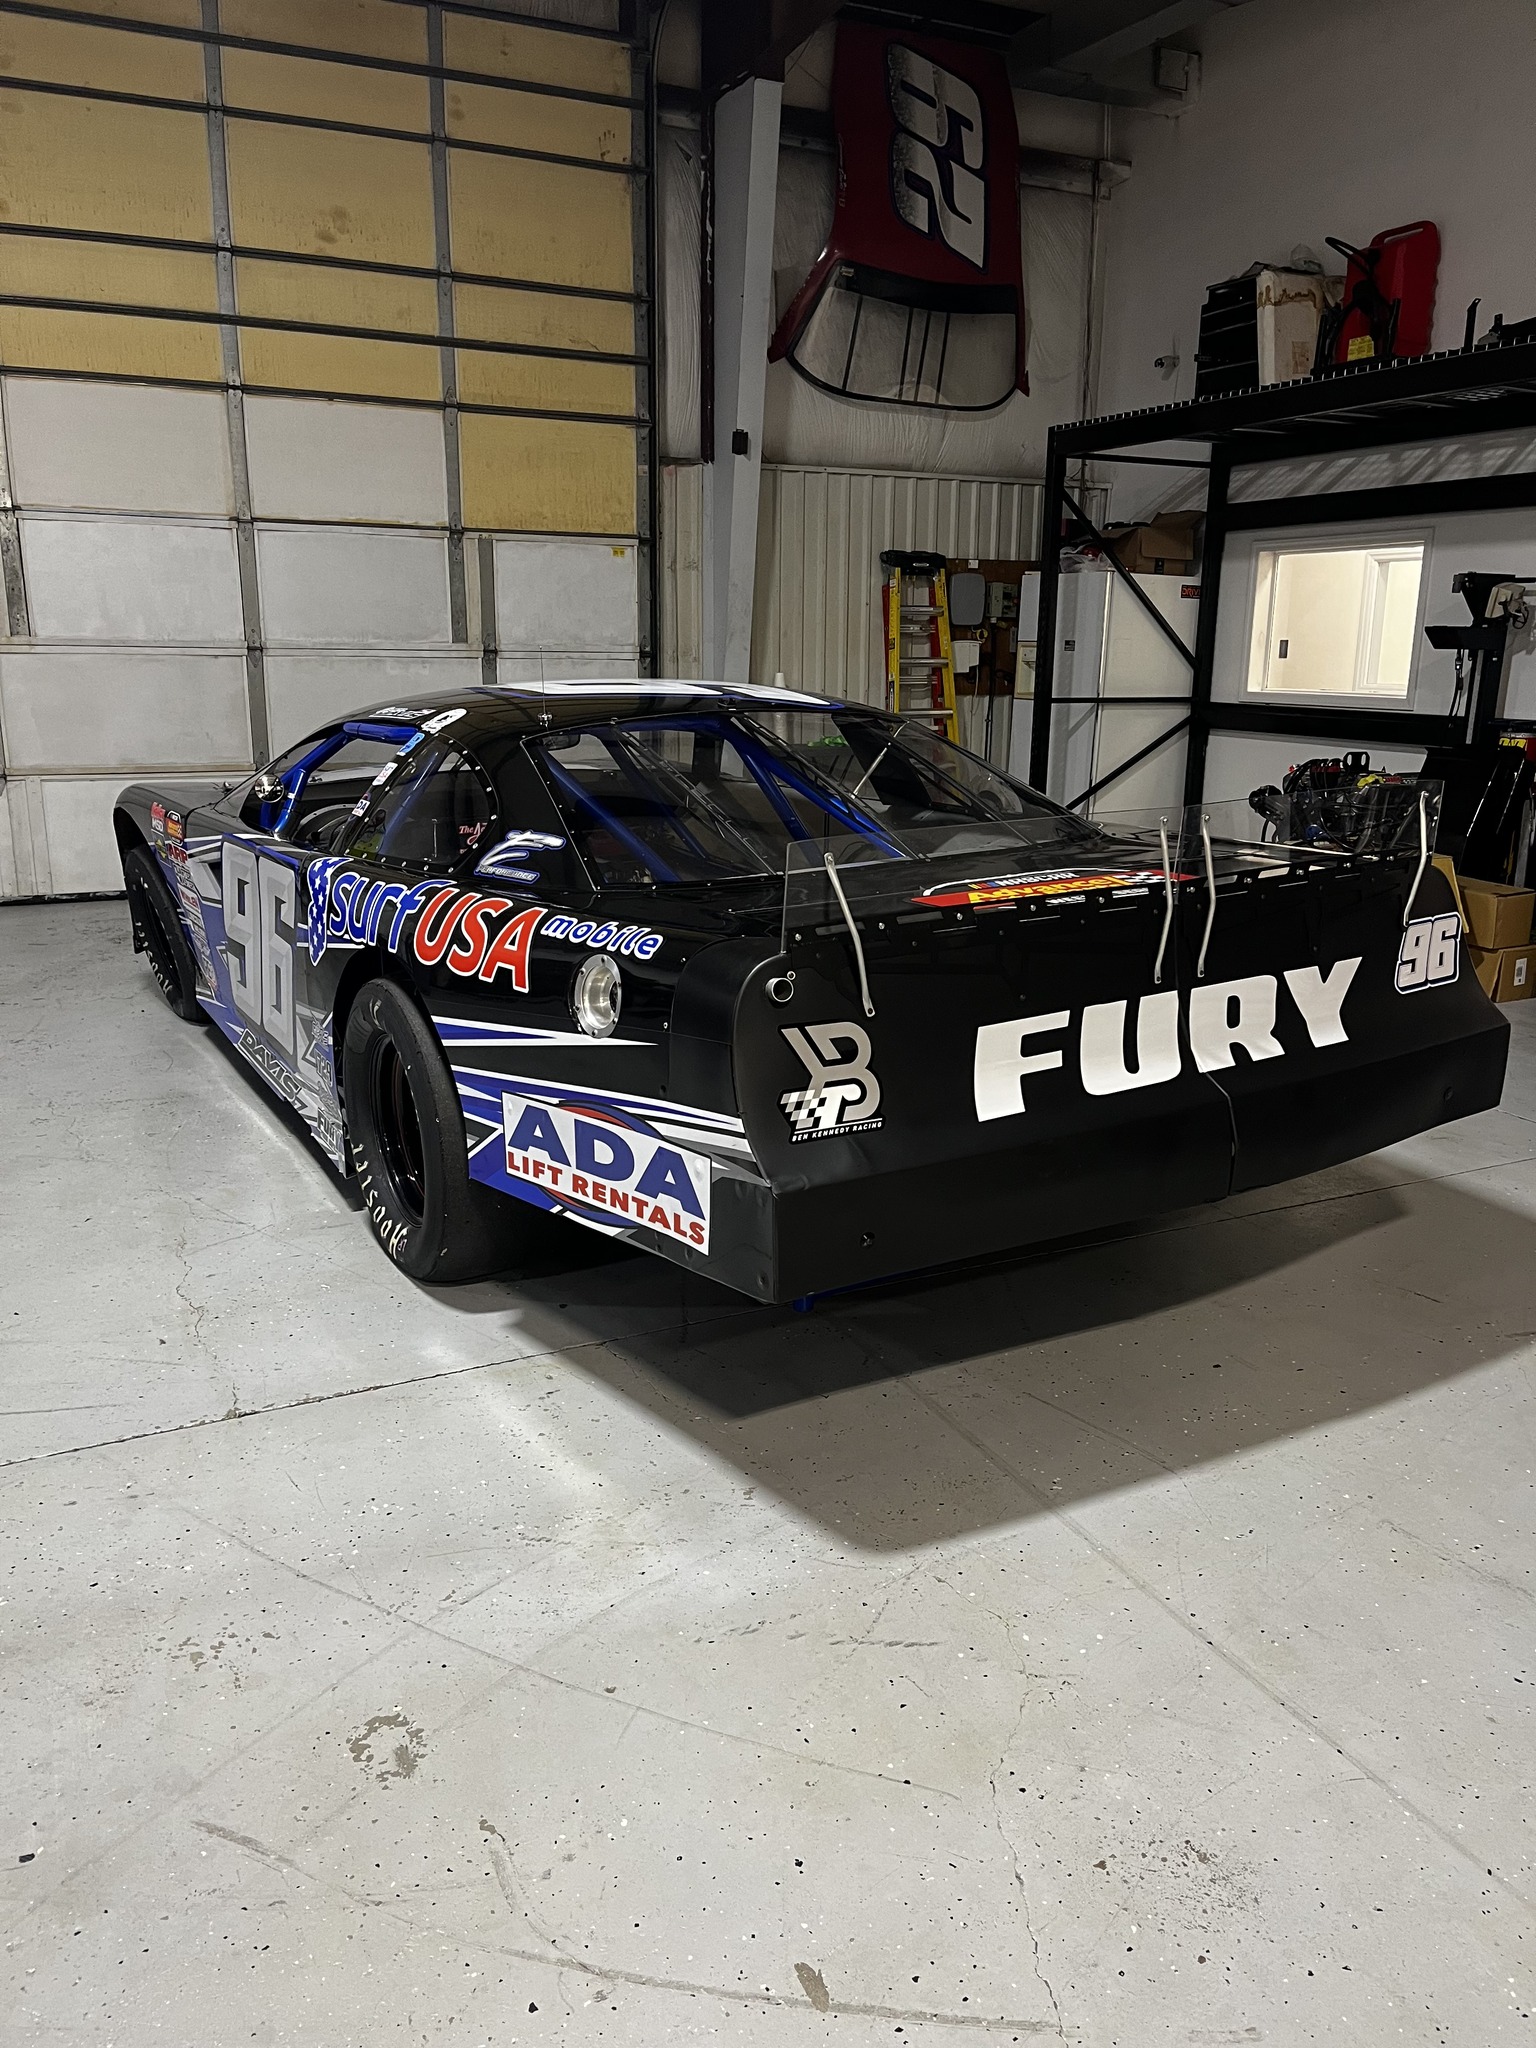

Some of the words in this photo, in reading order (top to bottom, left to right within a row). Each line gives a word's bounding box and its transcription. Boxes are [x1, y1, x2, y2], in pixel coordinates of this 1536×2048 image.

[968, 878, 1113, 904] Advance
[222, 841, 296, 1056] 96
[541, 914, 663, 960] mobile
[1396, 913, 1461, 993] 96
[238, 1028, 302, 1101] DAVIS
[973, 957, 1362, 1122] FURY
[508, 1105, 706, 1221] ADA
[792, 1133, 809, 1142] BEN
[812, 1126, 850, 1138] KENNEDY
[853, 1122, 882, 1132] RACING
[508, 1151, 562, 1186] LIFT
[572, 1173, 706, 1245] RENTALS
